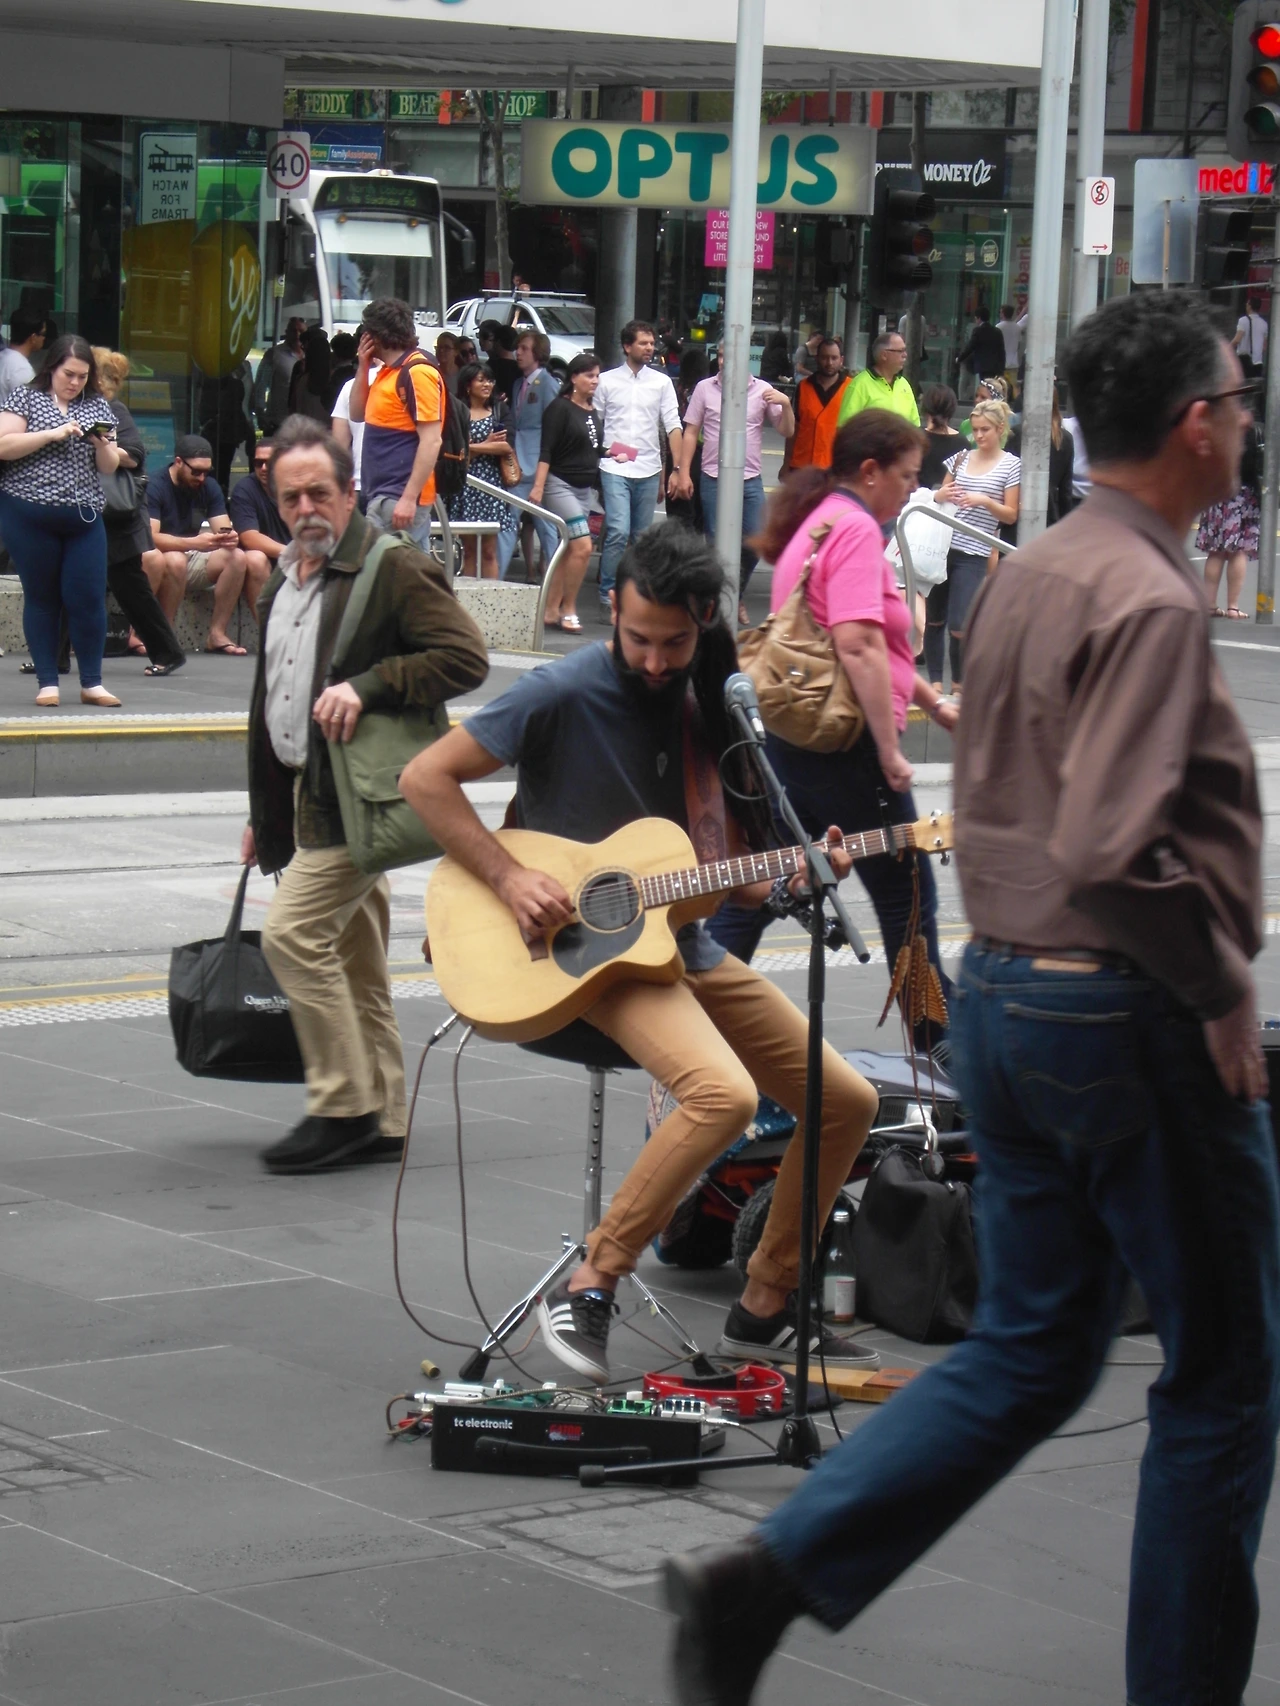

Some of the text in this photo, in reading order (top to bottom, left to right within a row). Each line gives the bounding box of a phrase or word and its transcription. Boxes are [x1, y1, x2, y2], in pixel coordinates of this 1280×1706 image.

[304, 93, 349, 113] TEDDY
[272, 153, 304, 177] 40
[924, 163, 973, 182] MONEY
[712, 220, 725, 229] OUR
[710, 231, 728, 240] STORE
[716, 242, 727, 251] THE
[714, 253, 727, 261] LITTL
[454, 1417, 513, 1430] tc electronic
